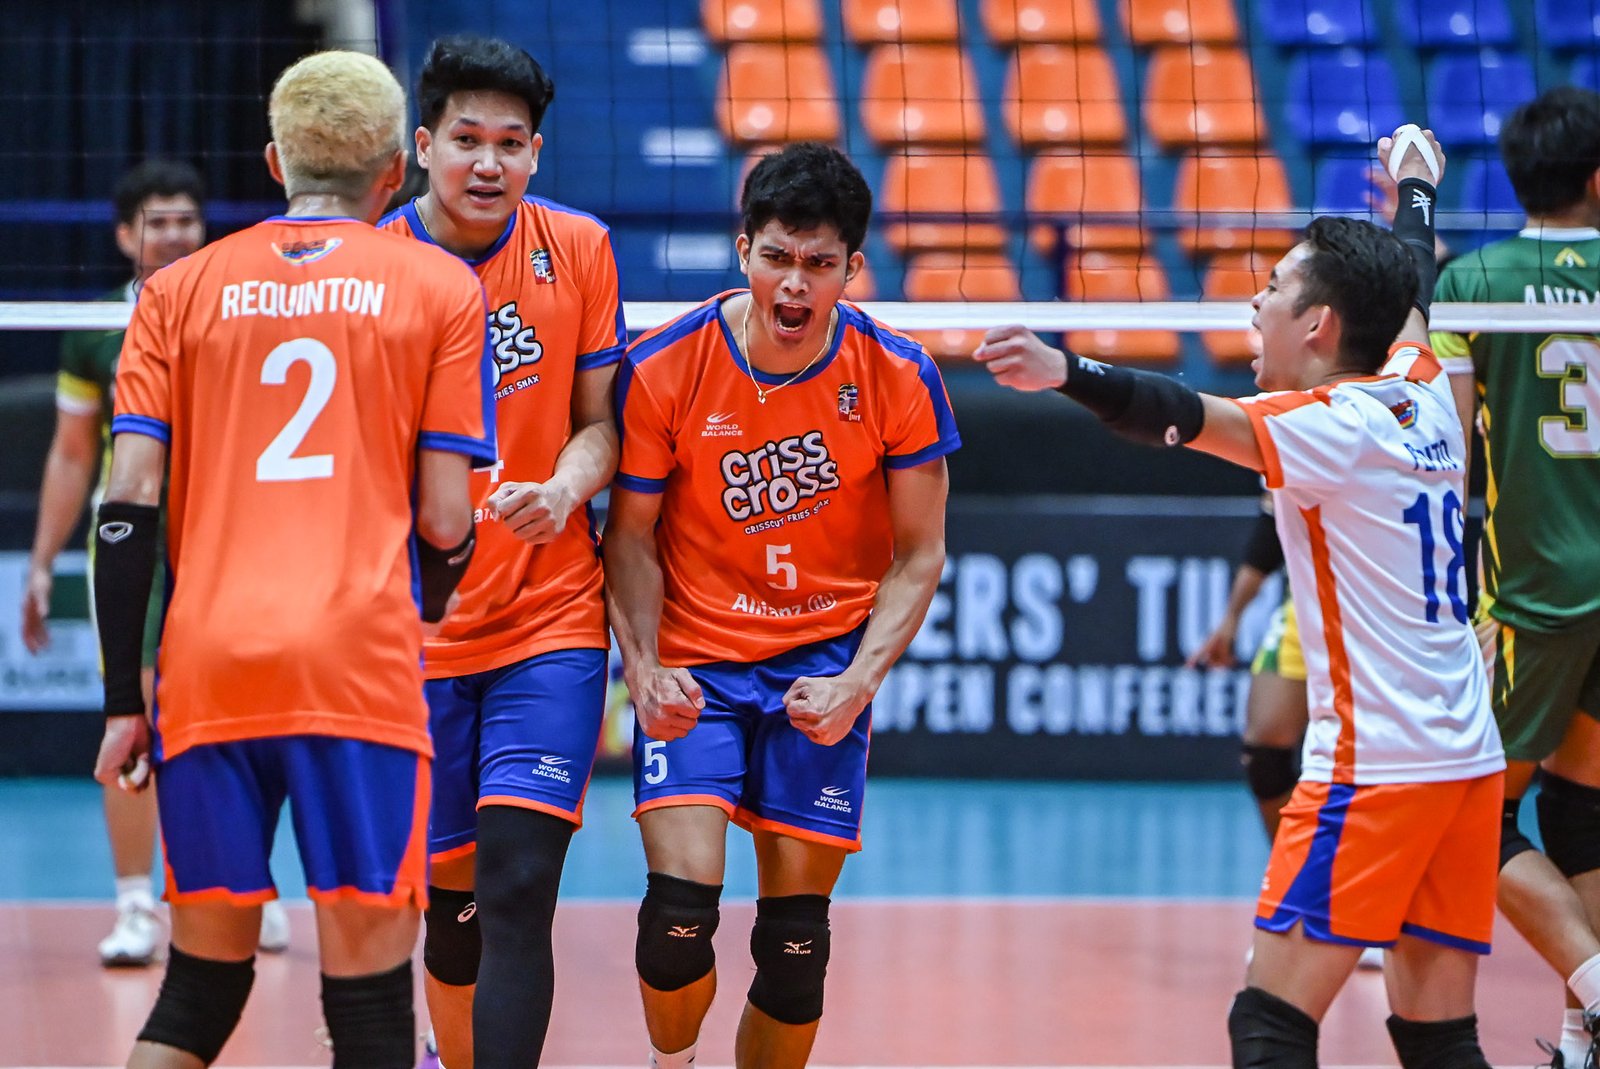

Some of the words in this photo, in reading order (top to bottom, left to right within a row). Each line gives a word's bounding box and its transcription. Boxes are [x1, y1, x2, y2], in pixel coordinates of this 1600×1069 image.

[222, 277, 385, 320] REQUINTON
[516, 375, 540, 390] SNAX
[1536, 334, 1600, 459] 3
[256, 337, 337, 481] 2
[744, 517, 785, 535] CRISSCUT
[787, 509, 810, 523] FRIES
[765, 543, 798, 591] 5
[1403, 490, 1467, 625] 18
[531, 769, 572, 784] BALANCE
[537, 764, 569, 777] WORLD
[644, 740, 669, 784] 5
[813, 800, 852, 814] BALANCE
[819, 795, 851, 806] WORLD
